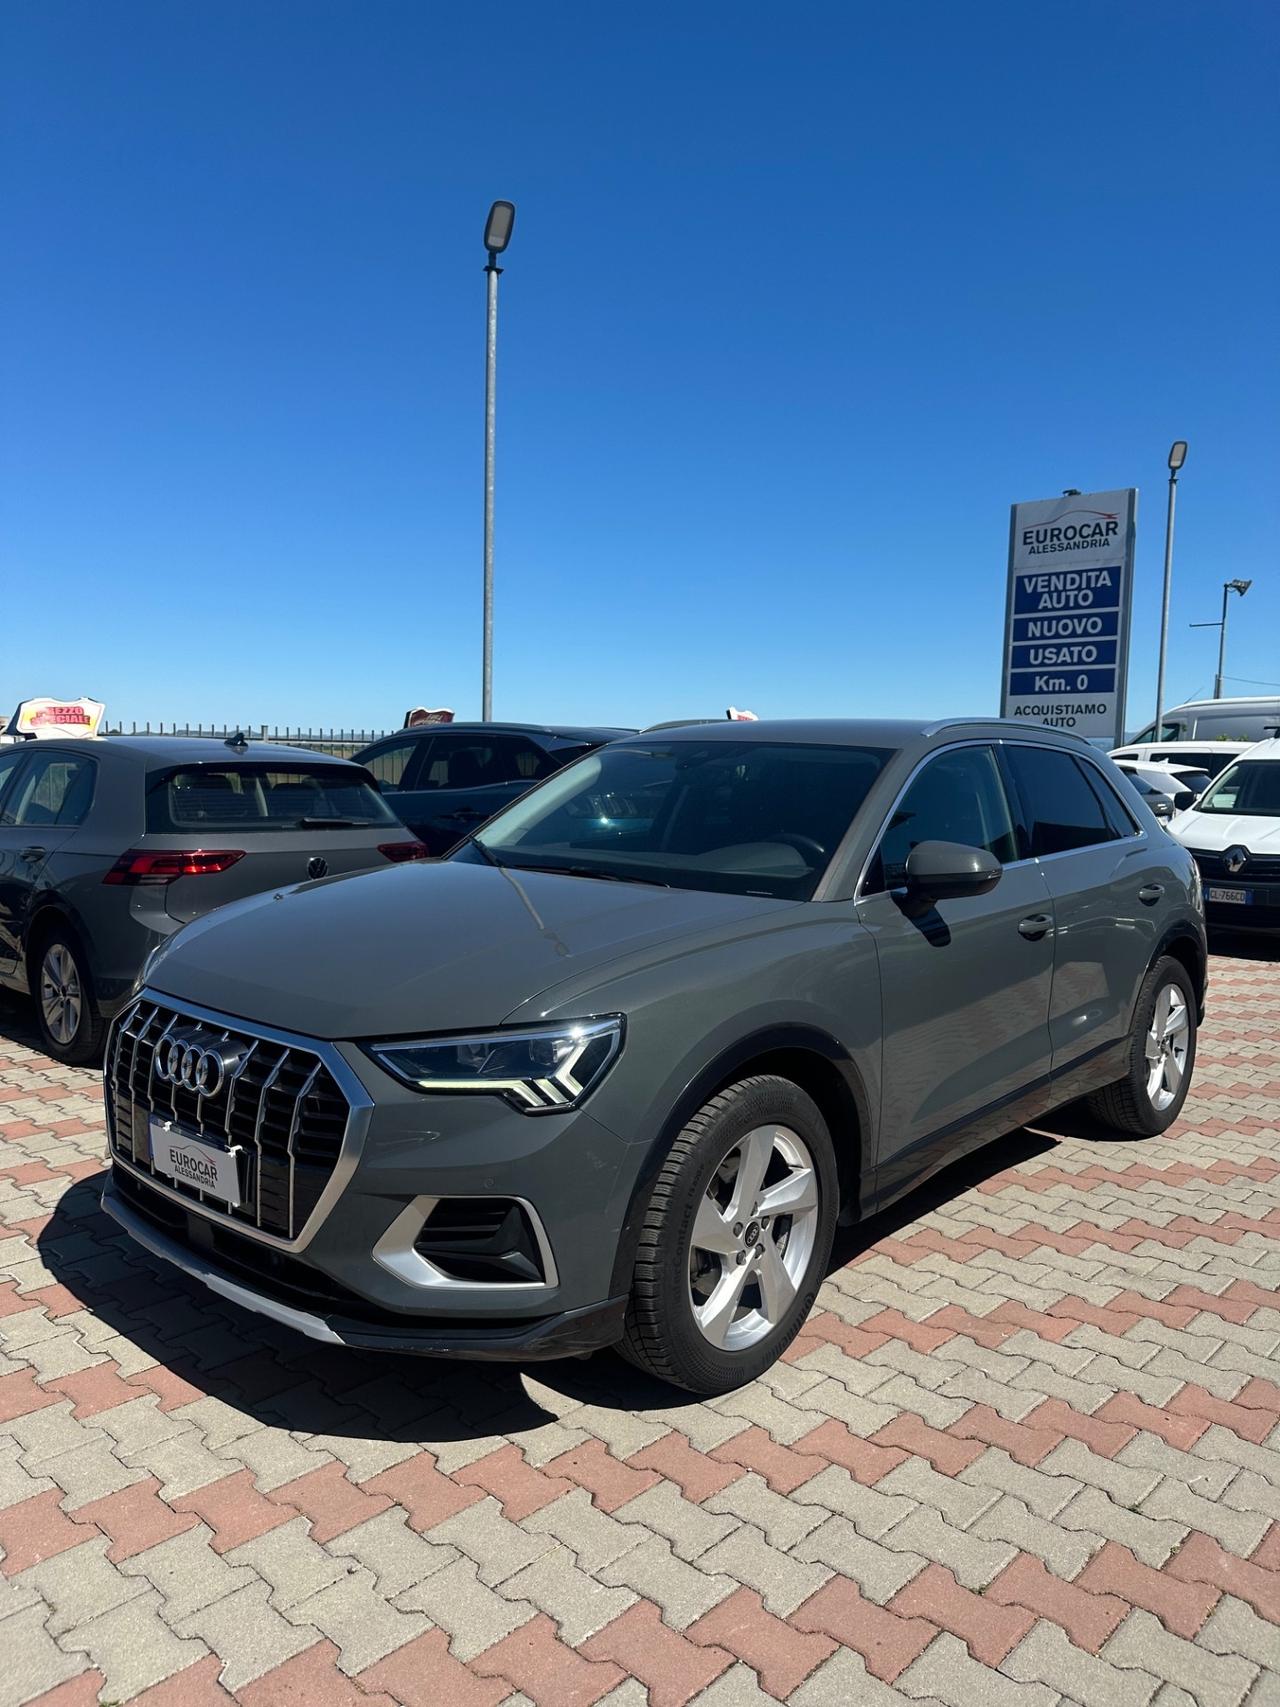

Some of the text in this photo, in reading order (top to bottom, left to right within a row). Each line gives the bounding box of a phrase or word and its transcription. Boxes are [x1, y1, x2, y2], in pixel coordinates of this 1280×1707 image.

[1022, 520, 1119, 546] EUROCAR
[1028, 537, 1110, 555] ALESSANDRIA
[1023, 570, 1112, 594] VENDITA
[1037, 589, 1094, 610] AUTO
[1027, 616, 1103, 638] NUOVO
[1029, 645, 1098, 665] USATO
[1034, 674, 1089, 692] Km. 0
[36, 706, 84, 716] REZZO
[1014, 703, 1107, 716] ACQUISTIAMO
[30, 715, 90, 726] SECIALE
[1042, 717, 1077, 728] AUTO
[169, 1148, 218, 1182] EUROCAR
[174, 1164, 216, 1189] ALESSANDRIA
